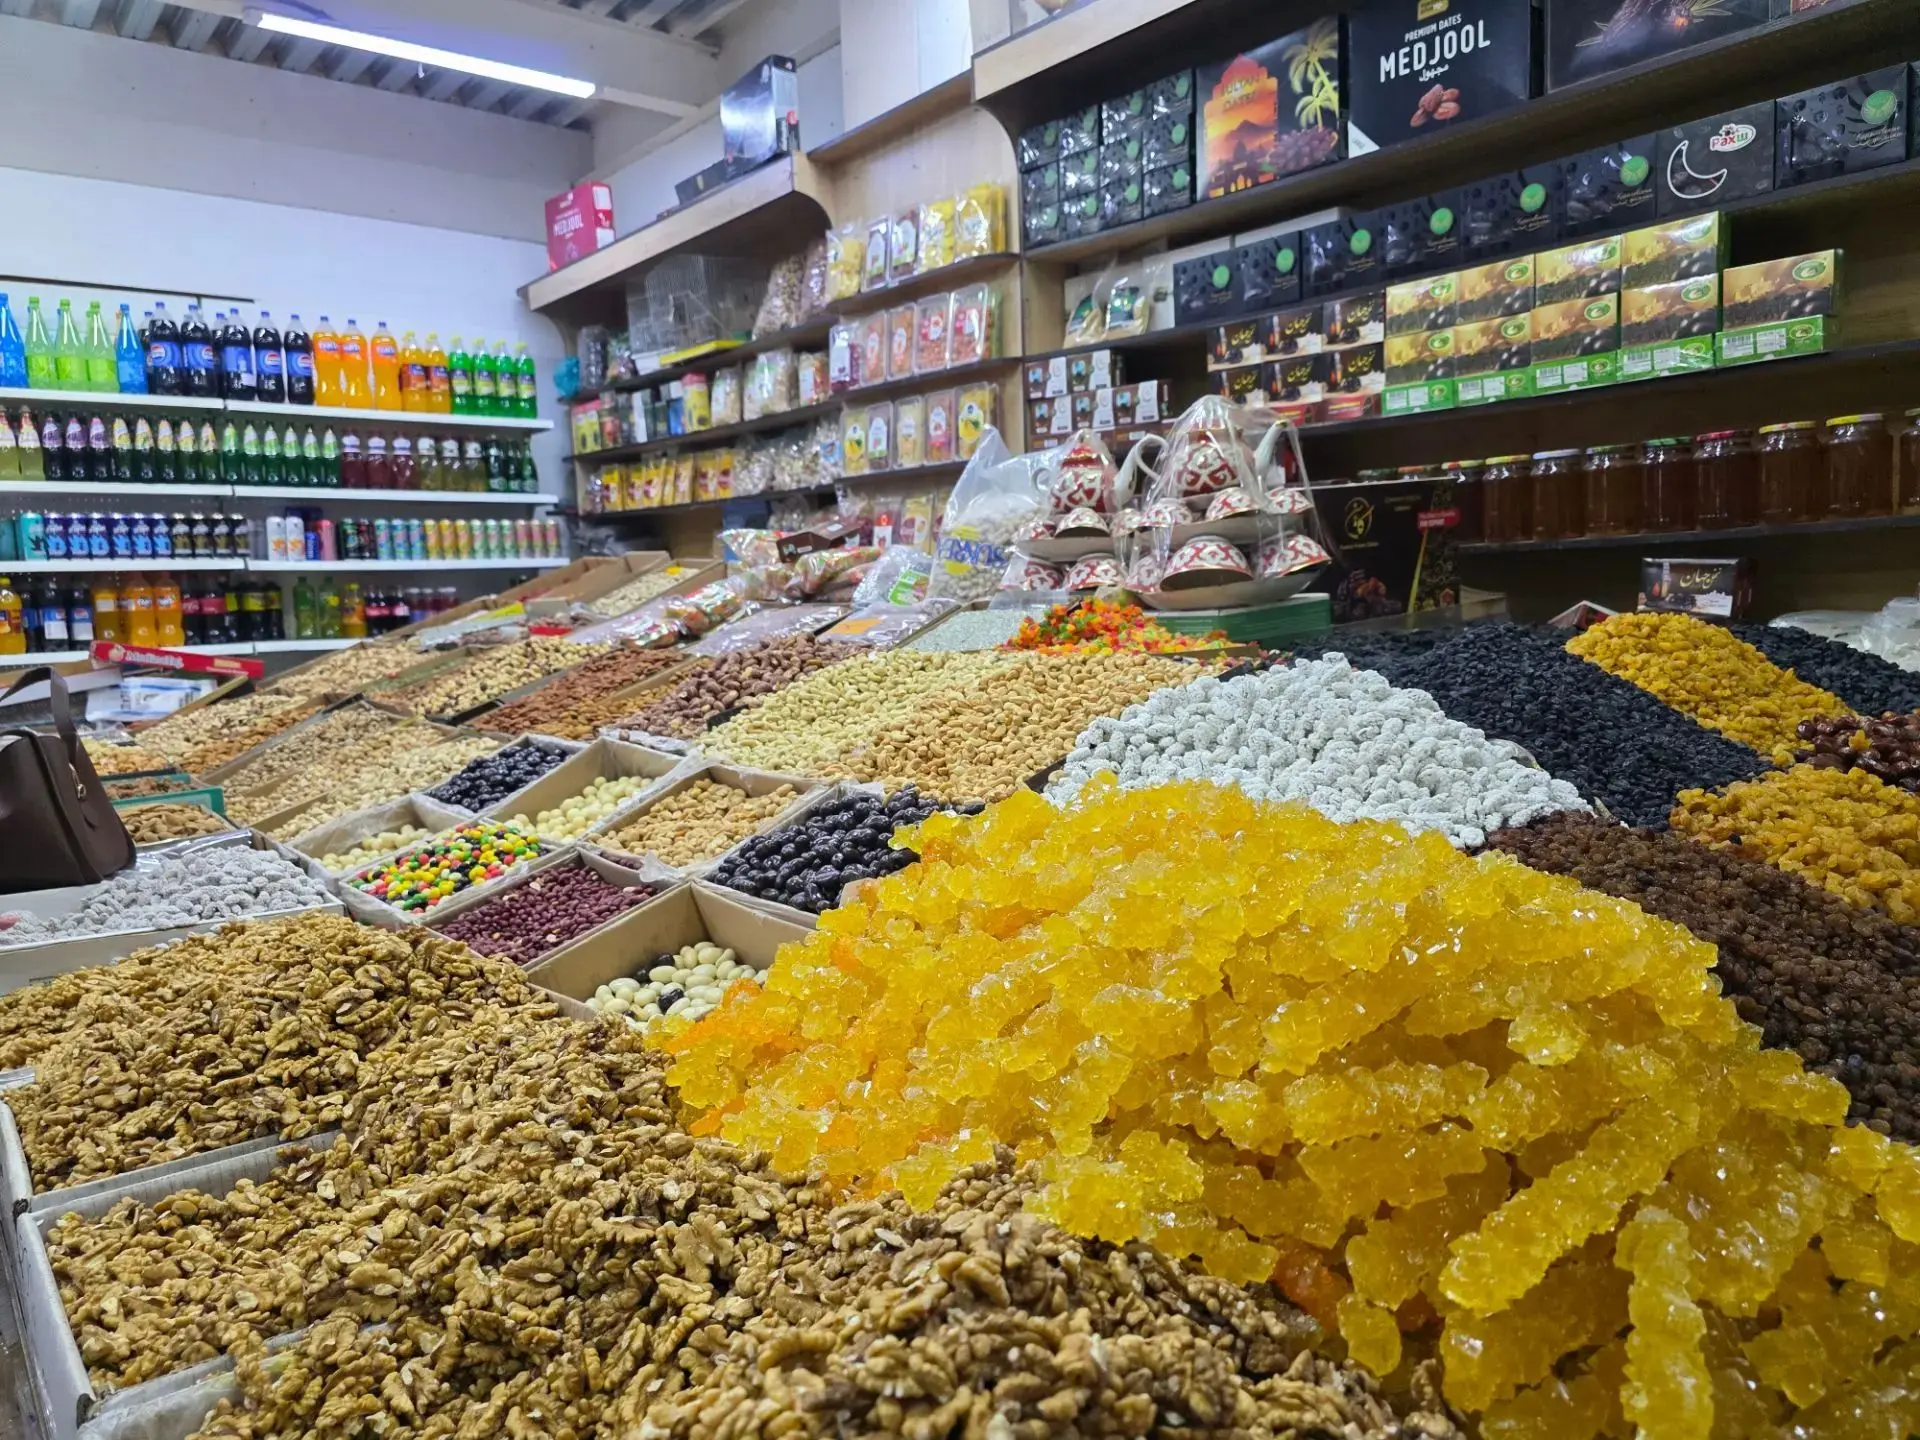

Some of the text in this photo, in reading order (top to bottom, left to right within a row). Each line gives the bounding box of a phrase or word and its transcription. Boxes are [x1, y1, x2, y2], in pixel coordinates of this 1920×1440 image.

[1404, 13, 1462, 43] PREMIUM DATES
[1379, 19, 1491, 83] MEDJOOL
[1418, 63, 1450, 82] مجهول
